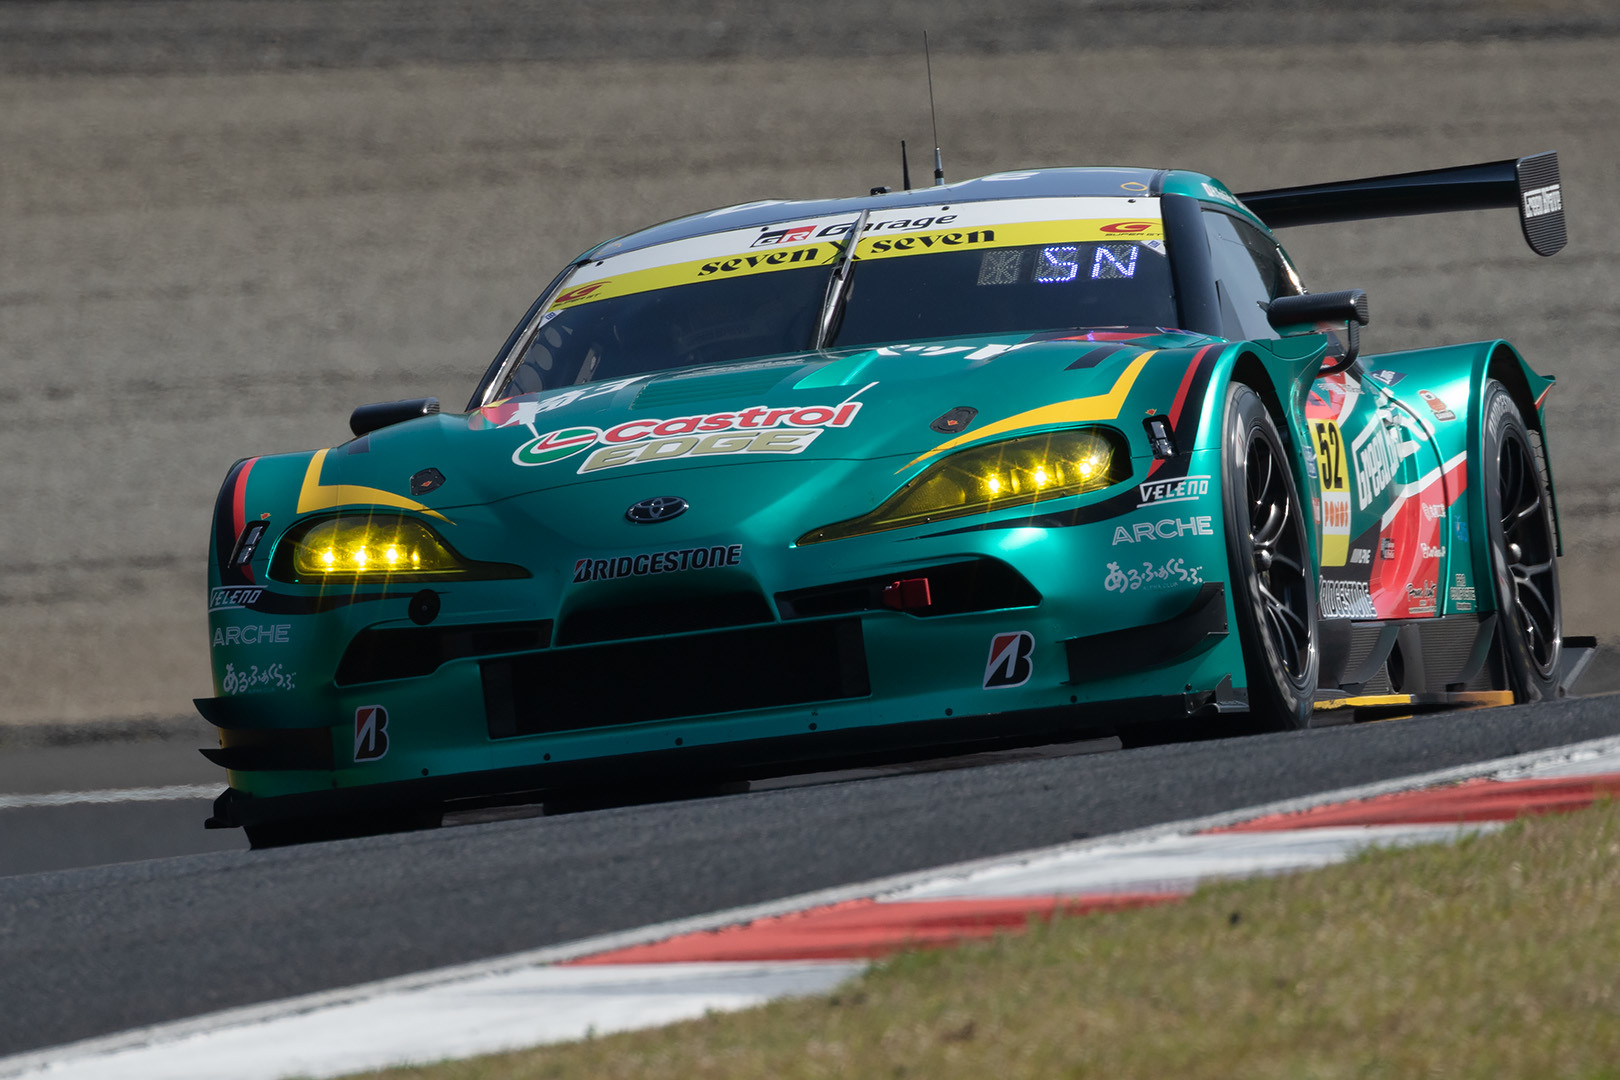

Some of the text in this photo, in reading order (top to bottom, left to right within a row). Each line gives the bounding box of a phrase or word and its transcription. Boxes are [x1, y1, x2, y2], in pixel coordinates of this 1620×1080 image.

[698, 247, 819, 277] seven
[870, 228, 995, 254] seven
[754, 228, 813, 247] GR
[603, 402, 861, 445] Castrol
[580, 429, 819, 473] EDGE
[1314, 421, 1344, 490] 52
[1139, 478, 1210, 503] VELENO
[1323, 501, 1349, 527] PONOS
[1111, 516, 1214, 546] ARCHE
[572, 544, 743, 584] BRIDGESTONE
[208, 588, 264, 608] VELENO
[212, 624, 292, 647] ARCHE
